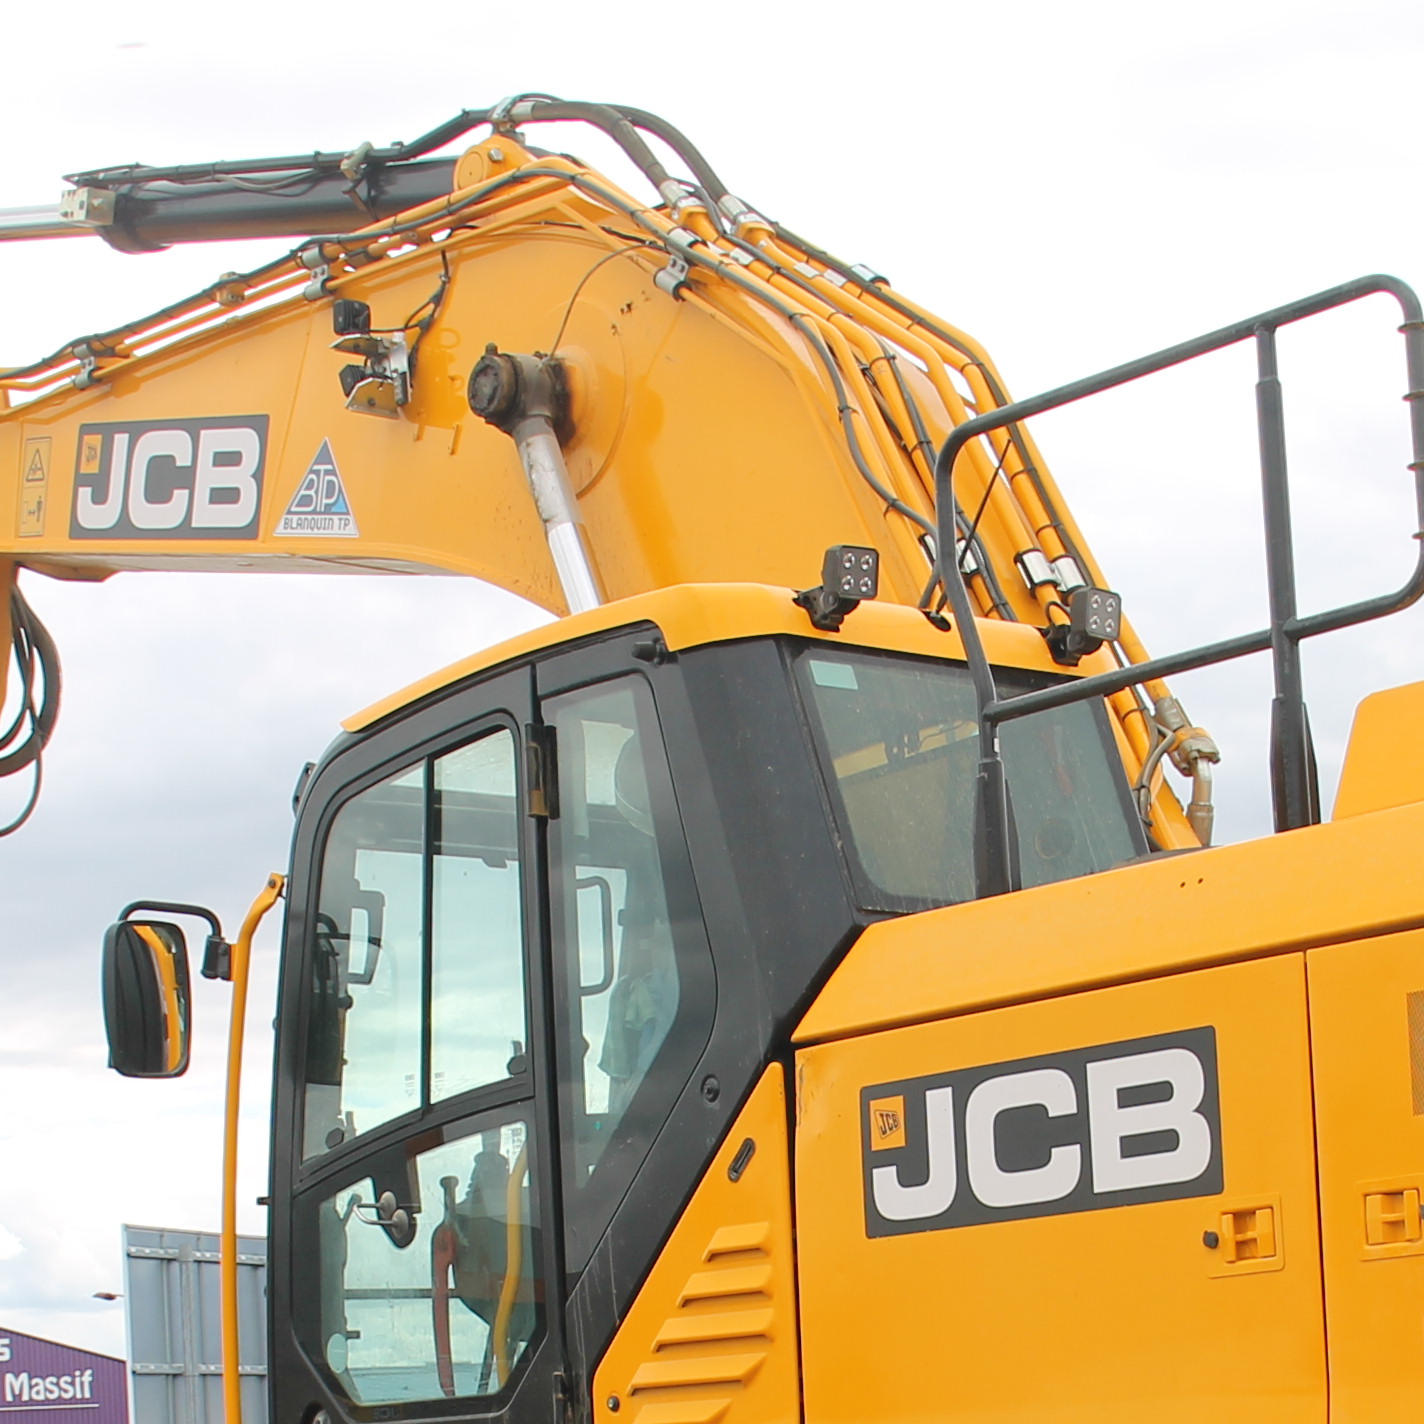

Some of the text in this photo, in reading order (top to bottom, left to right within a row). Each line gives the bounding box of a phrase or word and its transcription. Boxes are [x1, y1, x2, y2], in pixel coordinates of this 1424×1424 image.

[77, 427, 260, 530] JCB
[290, 464, 339, 512] BTP
[283, 517, 351, 531] BLANQUIN TP
[872, 1047, 1212, 1221] JCB
[5, 1368, 94, 1402] Massif
